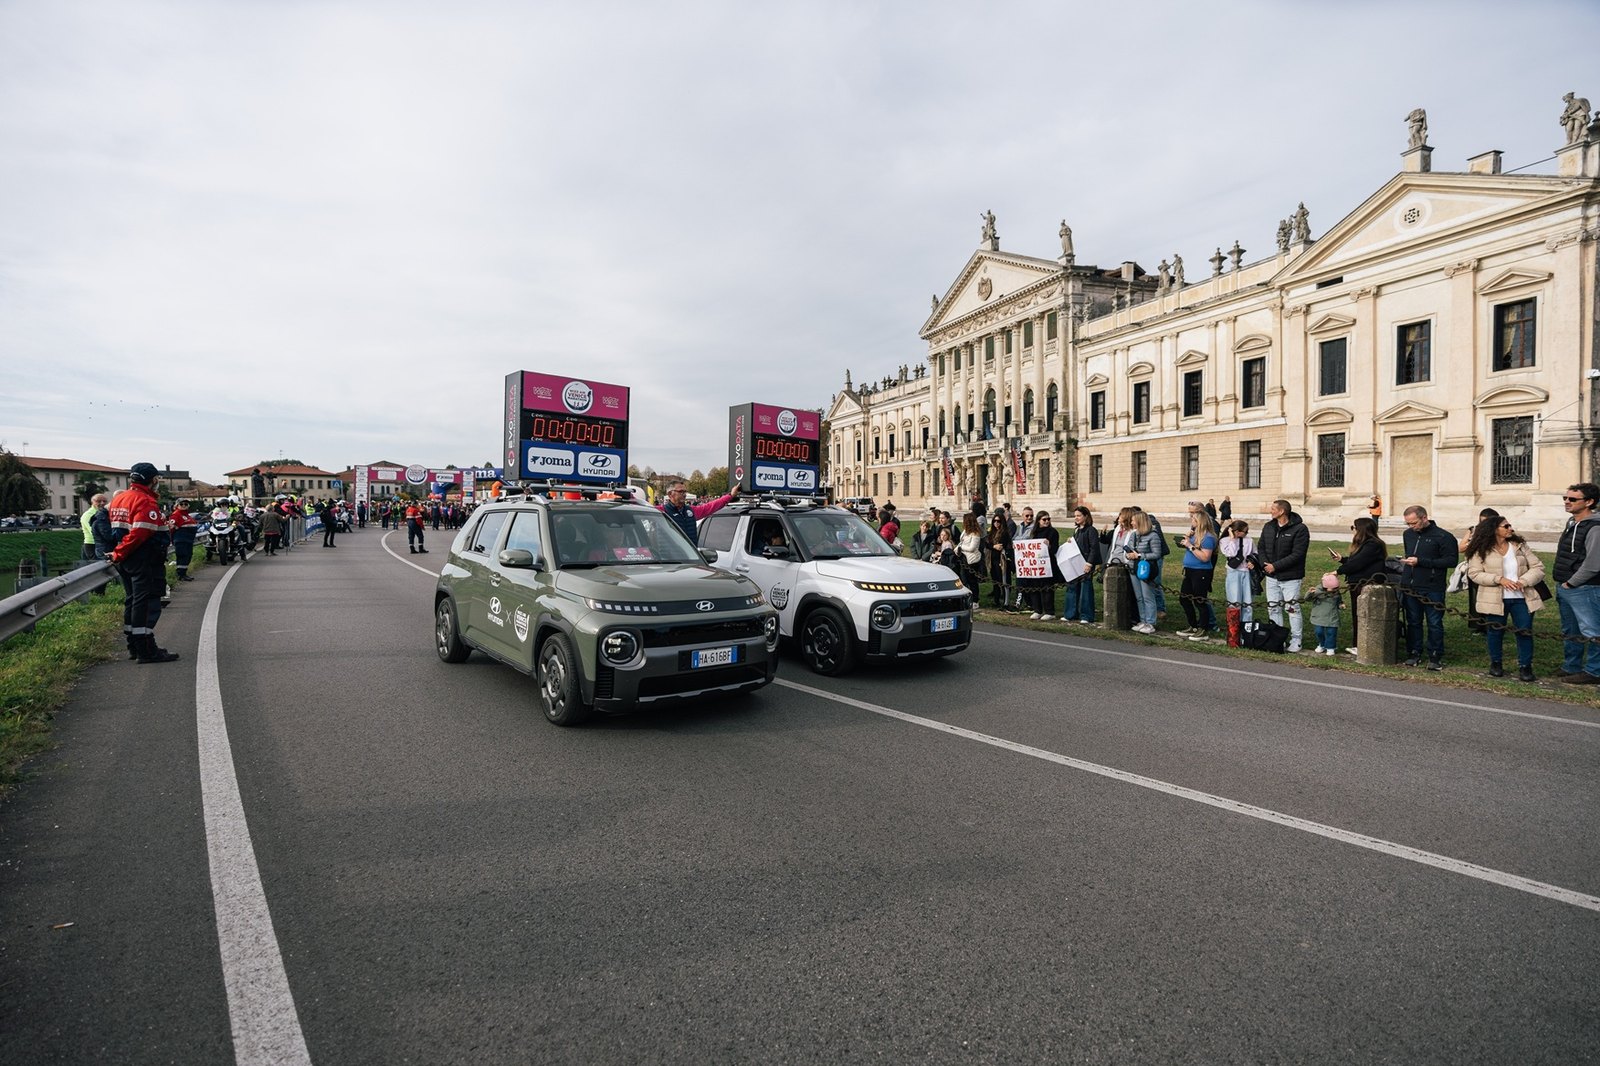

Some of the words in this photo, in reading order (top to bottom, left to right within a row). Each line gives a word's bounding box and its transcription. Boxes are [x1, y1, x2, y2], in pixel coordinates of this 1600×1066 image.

[533, 418, 614, 444] 00:00:00
[757, 440, 809, 459] 00:00:00
[476, 470, 496, 478] ma
[583, 468, 616, 476] HYUNDAI
[1019, 567, 1046, 576] SPRITZ
